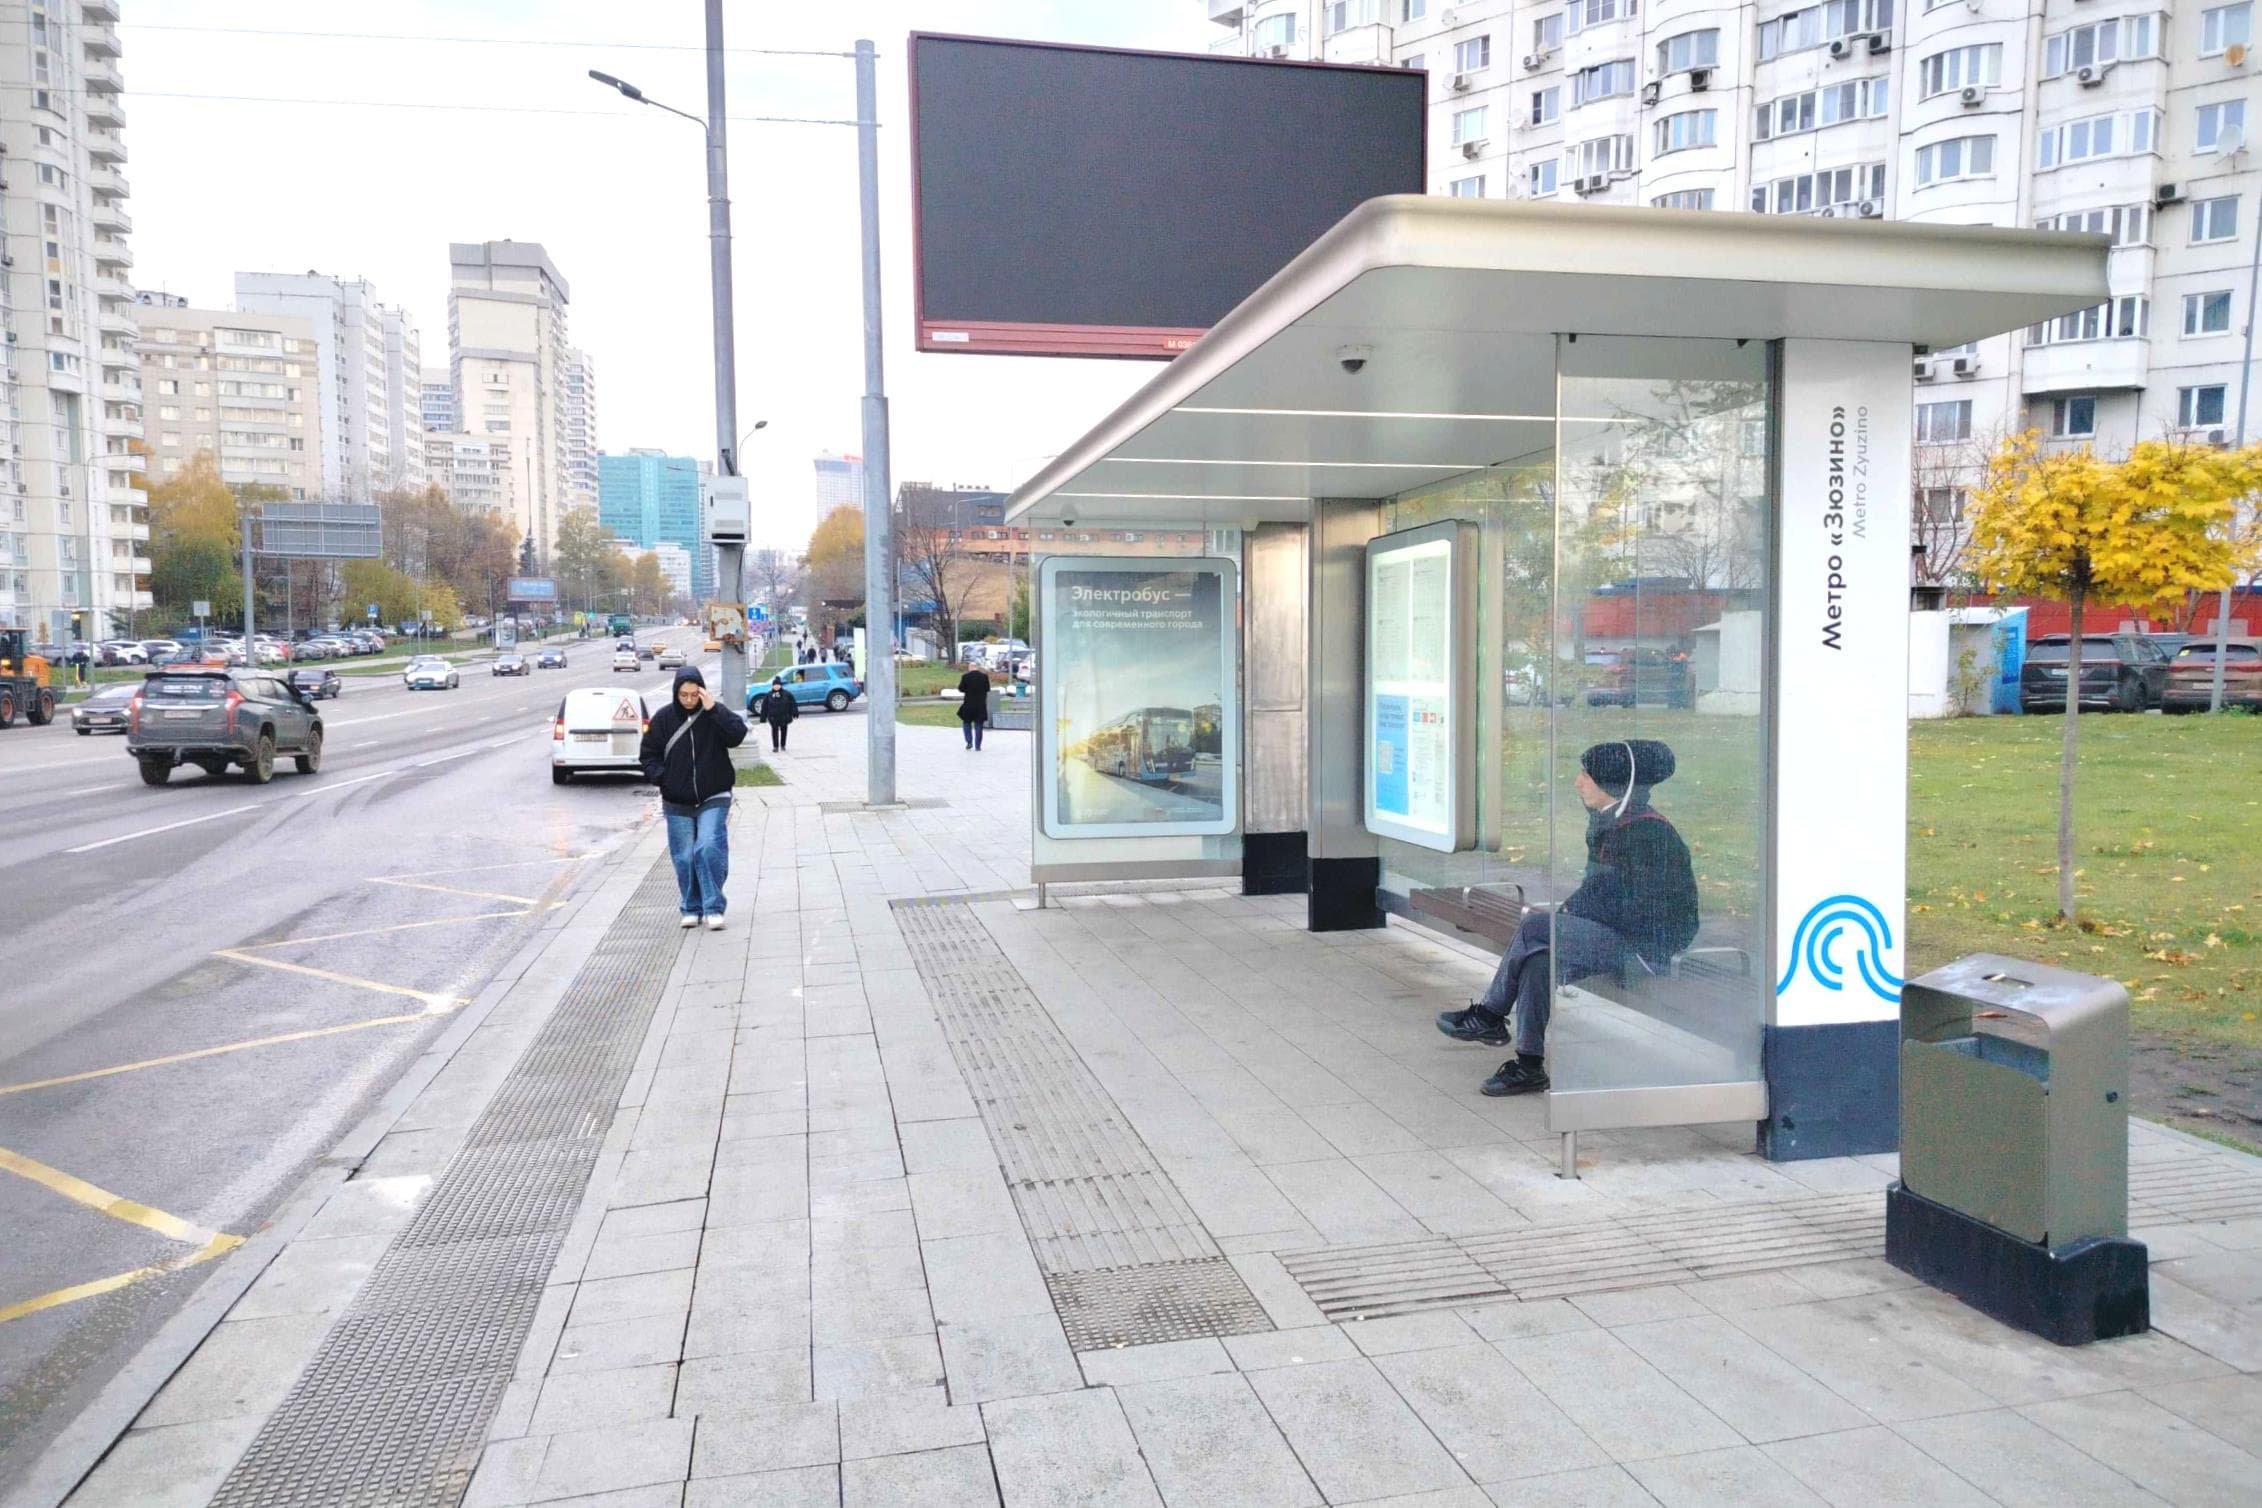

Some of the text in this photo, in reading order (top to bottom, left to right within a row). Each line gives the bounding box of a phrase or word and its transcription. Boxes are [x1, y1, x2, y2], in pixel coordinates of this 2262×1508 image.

[1852, 406, 1870, 539] Metro Zyuzino
[1822, 406, 1847, 650] Метро «Зюзино»
[1072, 585, 1170, 605] Электробус
[1093, 620, 1166, 630] современного
[1167, 621, 1203, 630] города
[1141, 610, 1192, 620] транспорт
